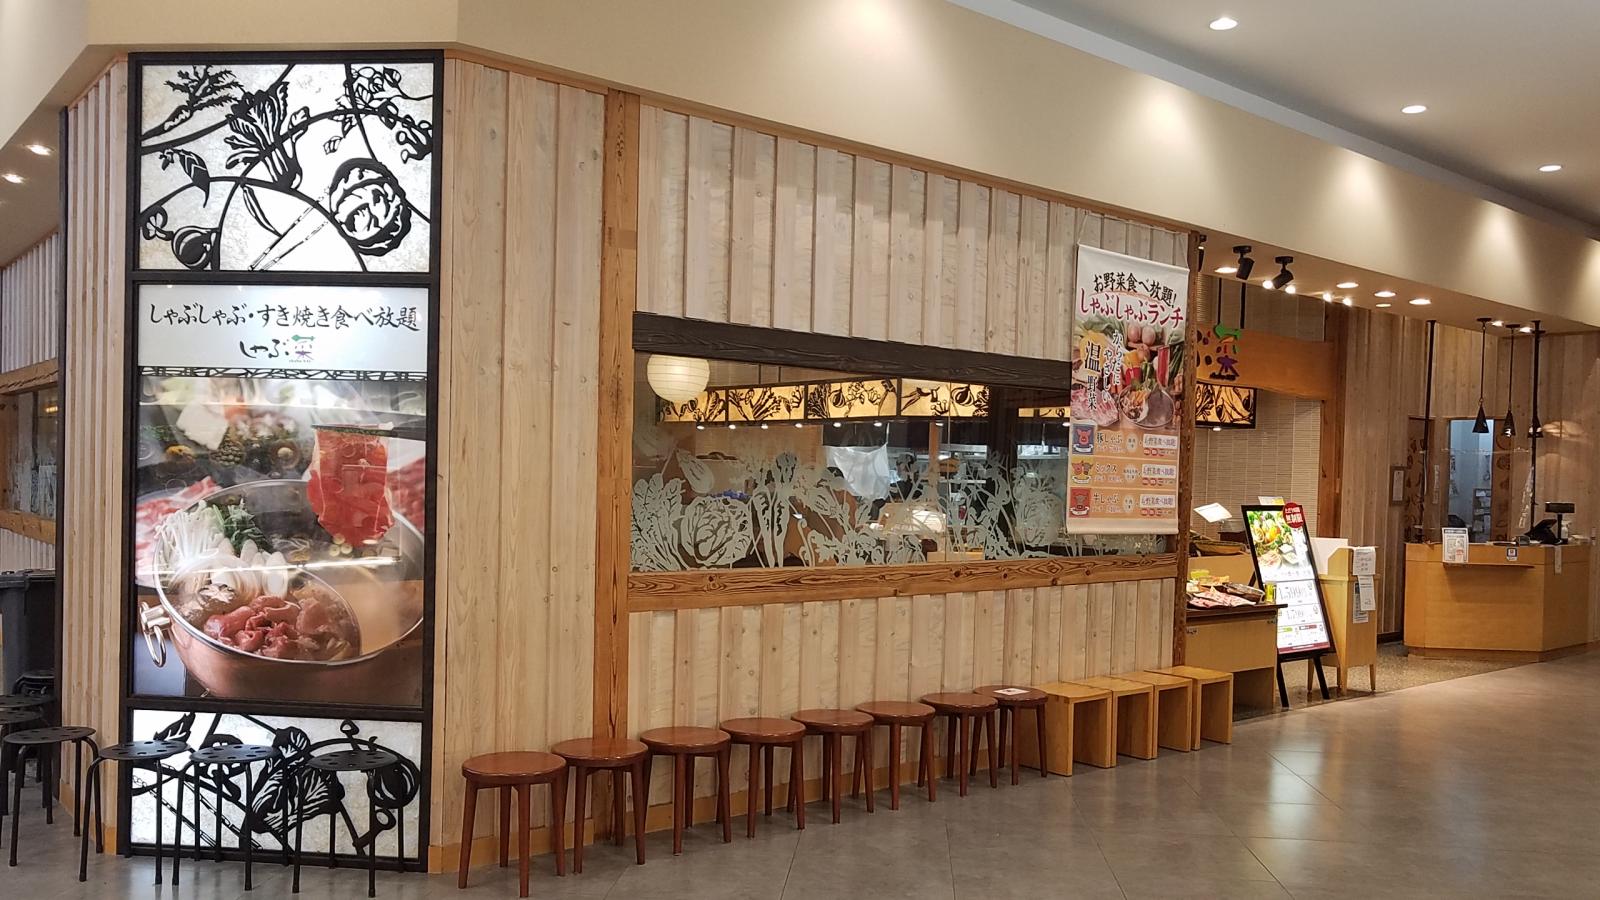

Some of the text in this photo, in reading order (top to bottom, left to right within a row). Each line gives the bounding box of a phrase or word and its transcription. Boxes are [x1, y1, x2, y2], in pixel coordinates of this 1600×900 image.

[1080, 287, 1184, 328] しゃぶしゃぶランチ
[1102, 349, 1112, 402] やさしい
[1112, 330, 1123, 384] からだに
